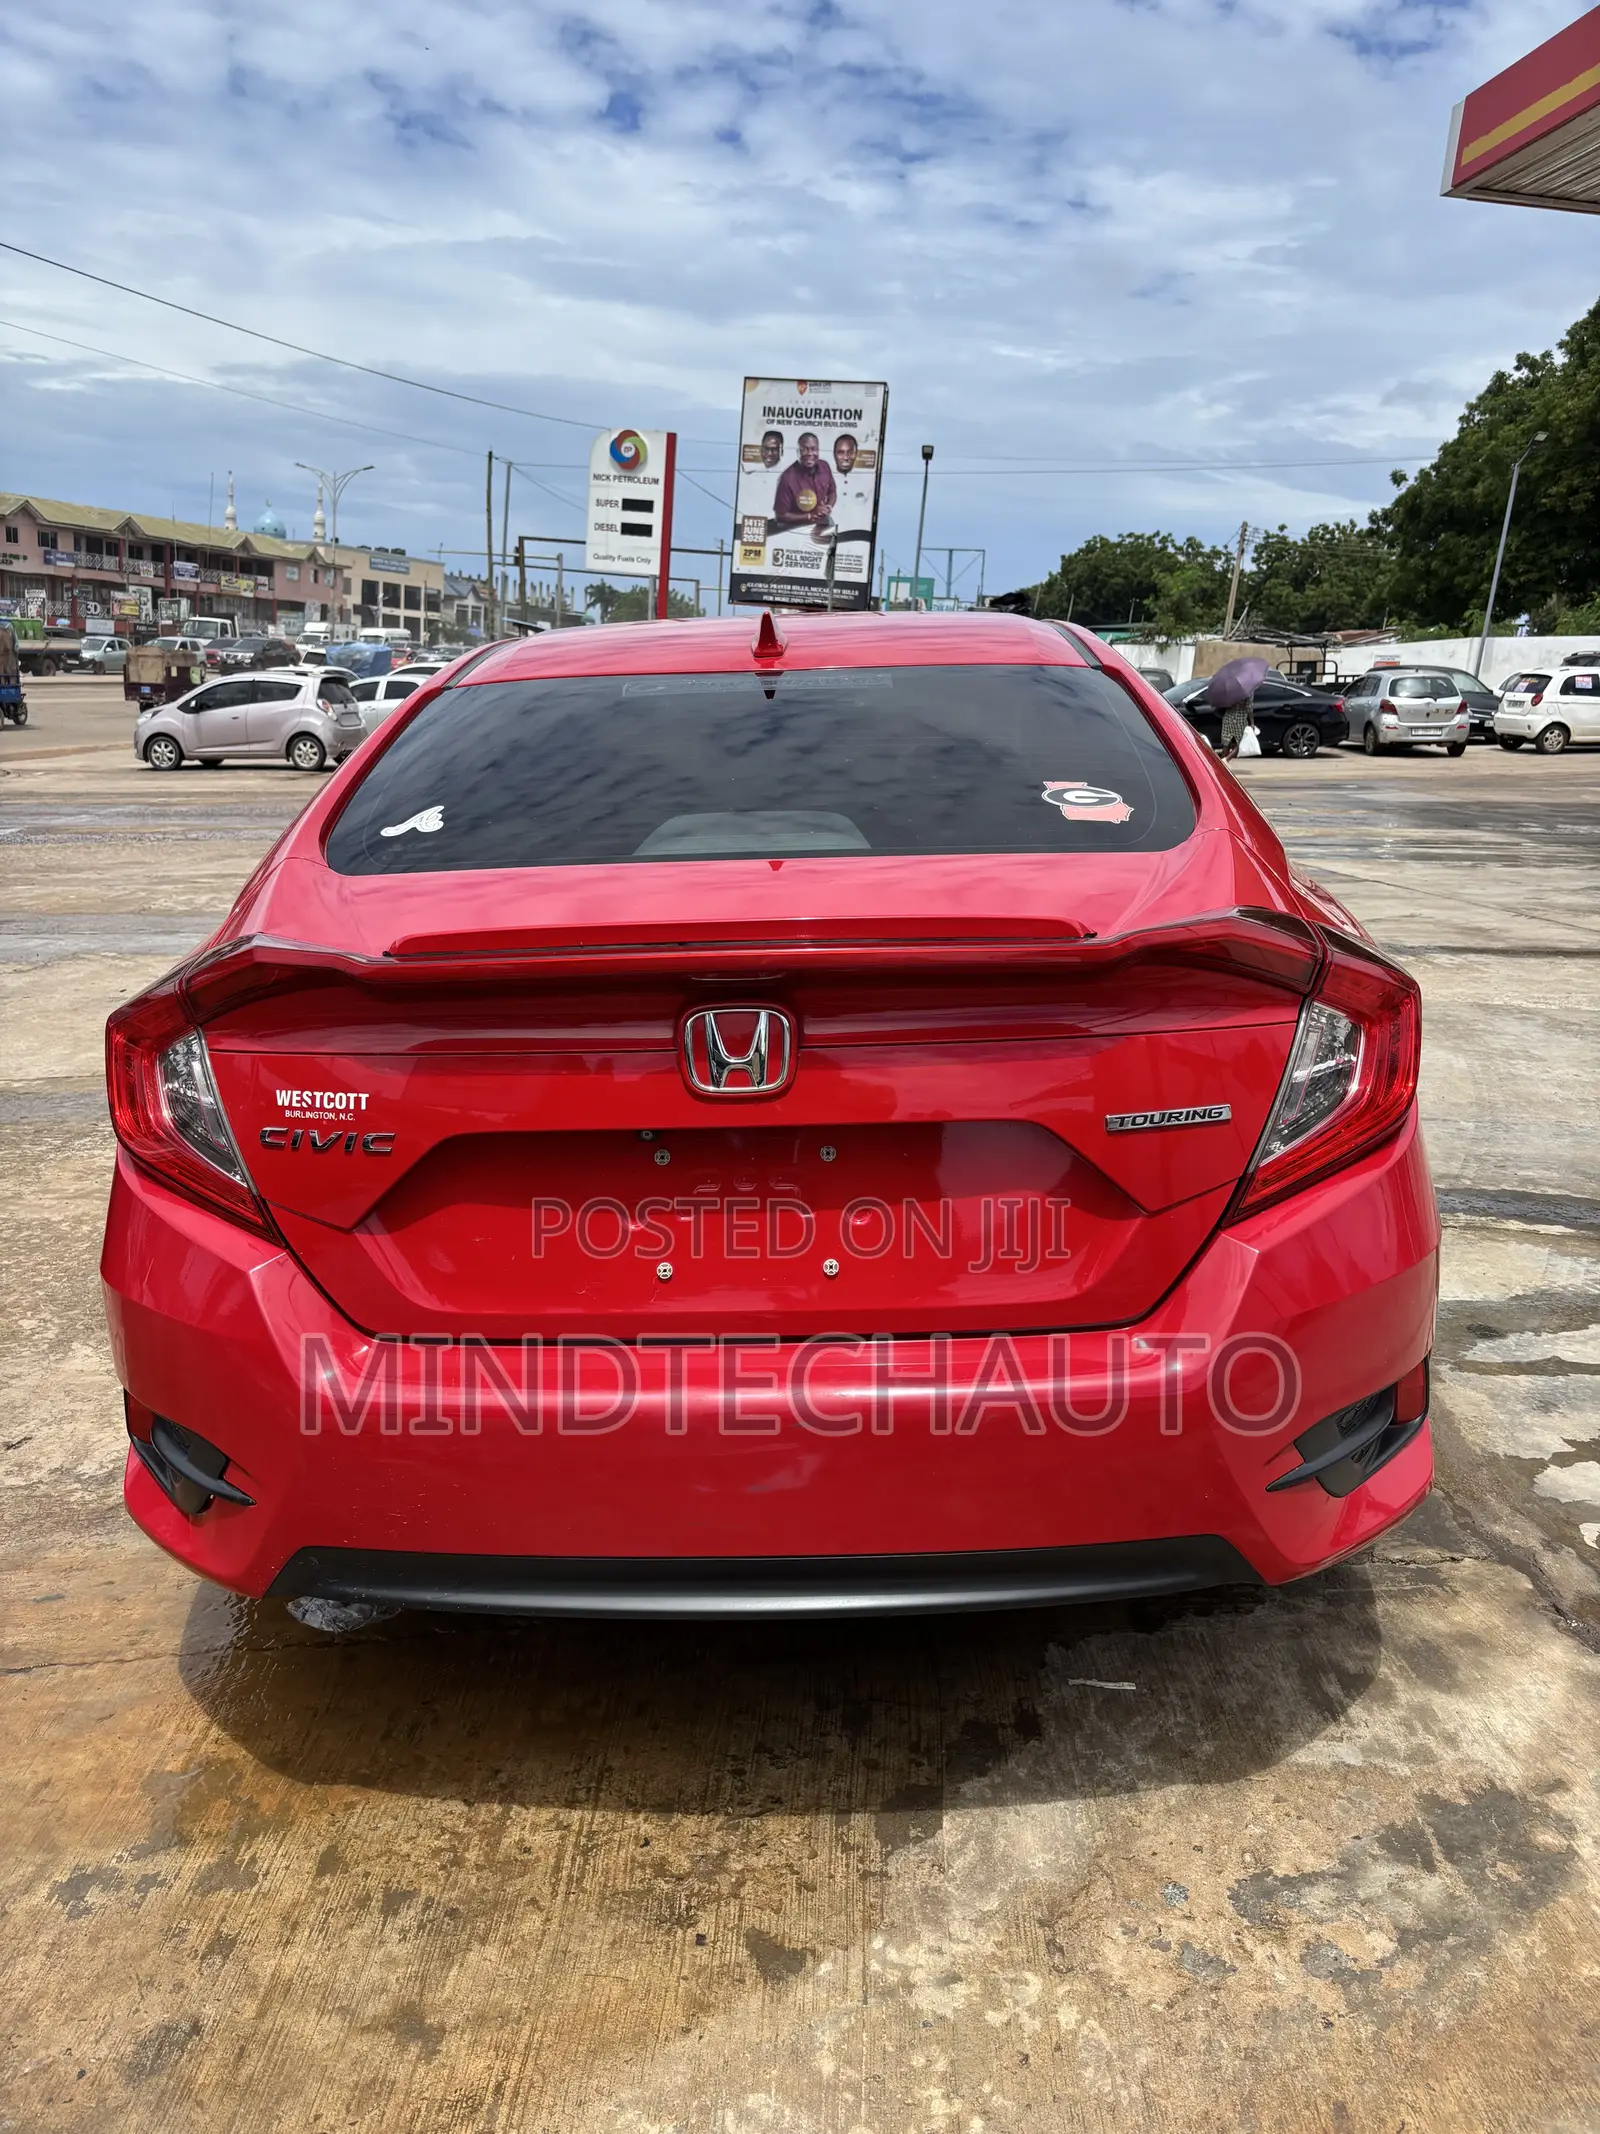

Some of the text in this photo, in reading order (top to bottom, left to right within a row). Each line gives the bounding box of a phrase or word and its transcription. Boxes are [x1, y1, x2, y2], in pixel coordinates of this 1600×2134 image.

[762, 405, 863, 421] INAUGURATION
[793, 419, 823, 427] CHURCH
[824, 421, 858, 429] BUILDING
[593, 473, 659, 485] NICK PETROLEUM
[595, 498, 620, 508] SUPER
[594, 522, 619, 533] DIESEL
[743, 526, 765, 535] JUNE
[743, 549, 761, 557] 2PM
[593, 553, 652, 565] Quality Fuels Only
[800, 555, 823, 563] NIGHT
[784, 561, 820, 570] SERVICES
[86, 601, 100, 614] 3D
[275, 1089, 370, 1111] WESTCOTT
[285, 1110, 356, 1121] BURLINGTON, N.C.
[1113, 1106, 1225, 1128] TOURING
[259, 1126, 397, 1153] CIVIC
